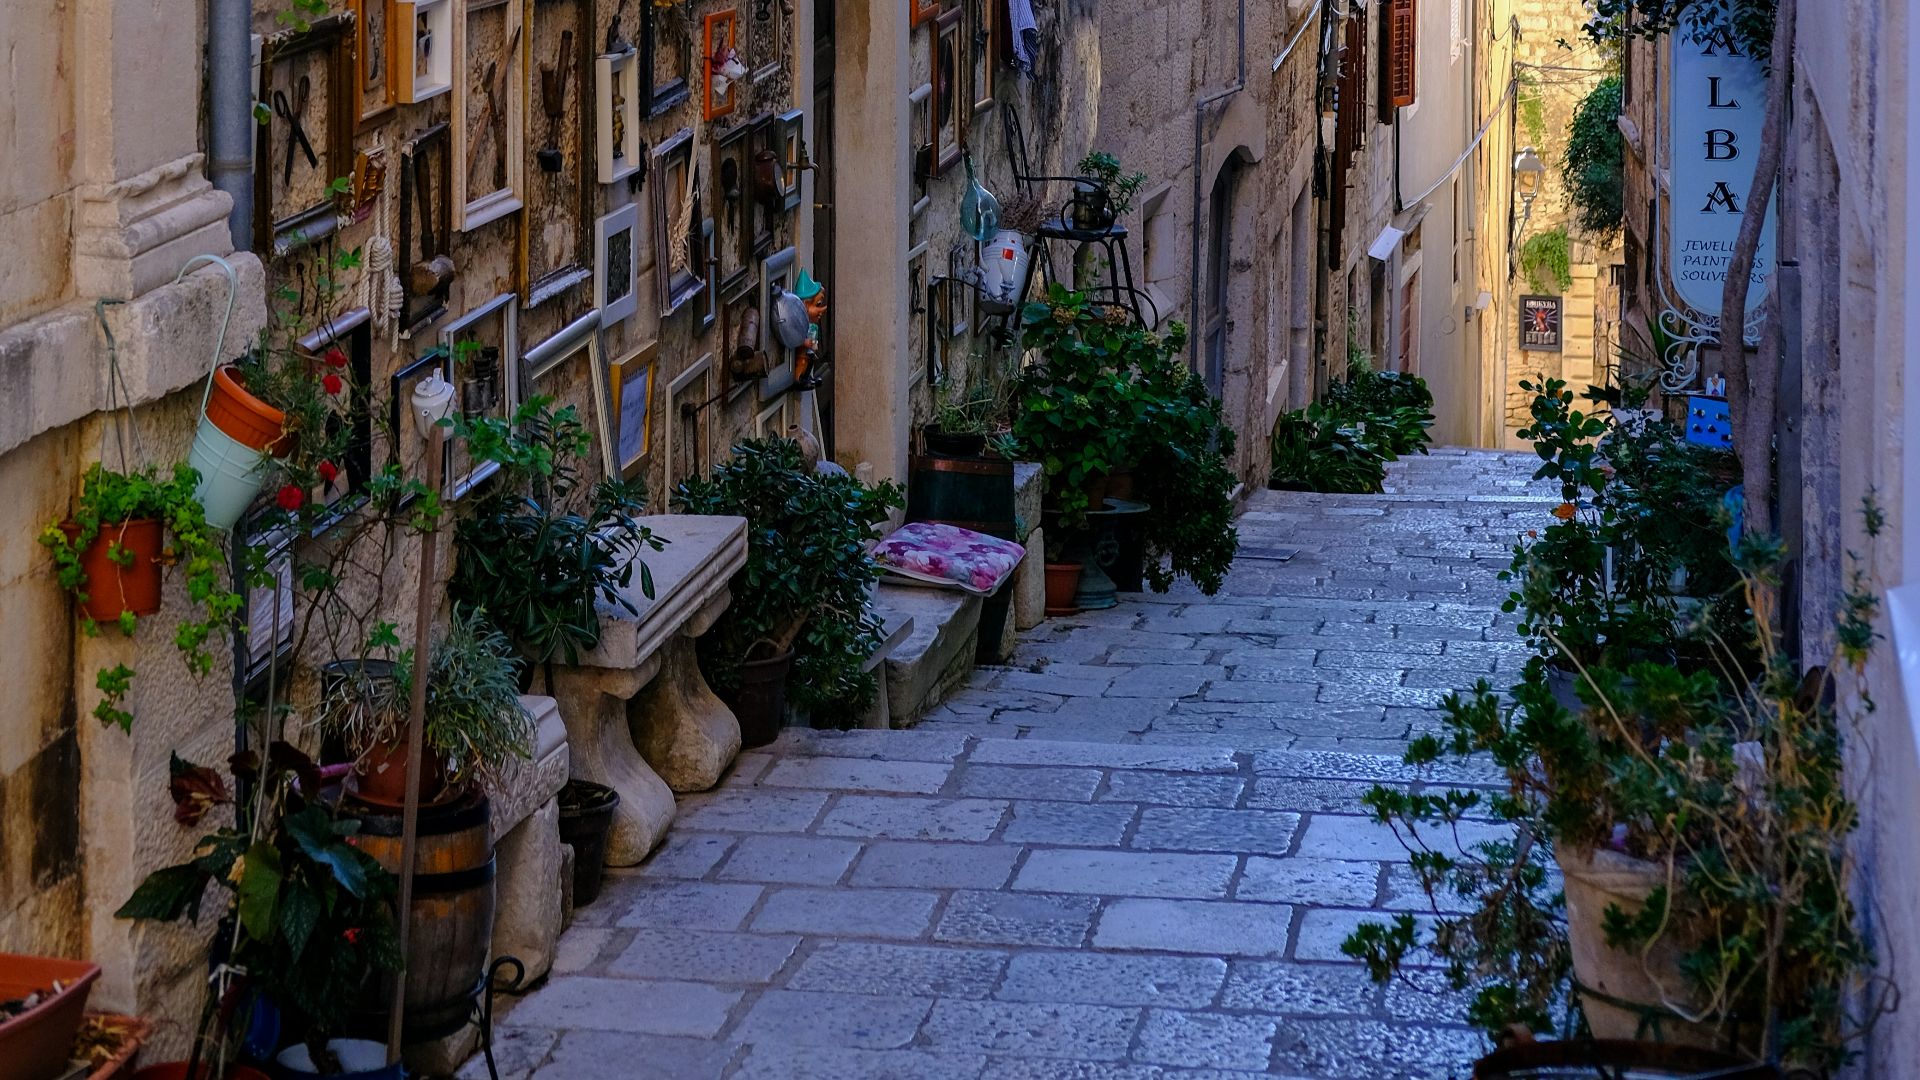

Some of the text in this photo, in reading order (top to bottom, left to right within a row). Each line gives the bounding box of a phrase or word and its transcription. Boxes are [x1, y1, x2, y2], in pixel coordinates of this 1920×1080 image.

[1700, 24, 1746, 214] ALBA
[1681, 240, 1765, 253] JEWELLY
[1683, 255, 1764, 269] PAINTGS
[1680, 270, 1765, 284] SOUVERS
